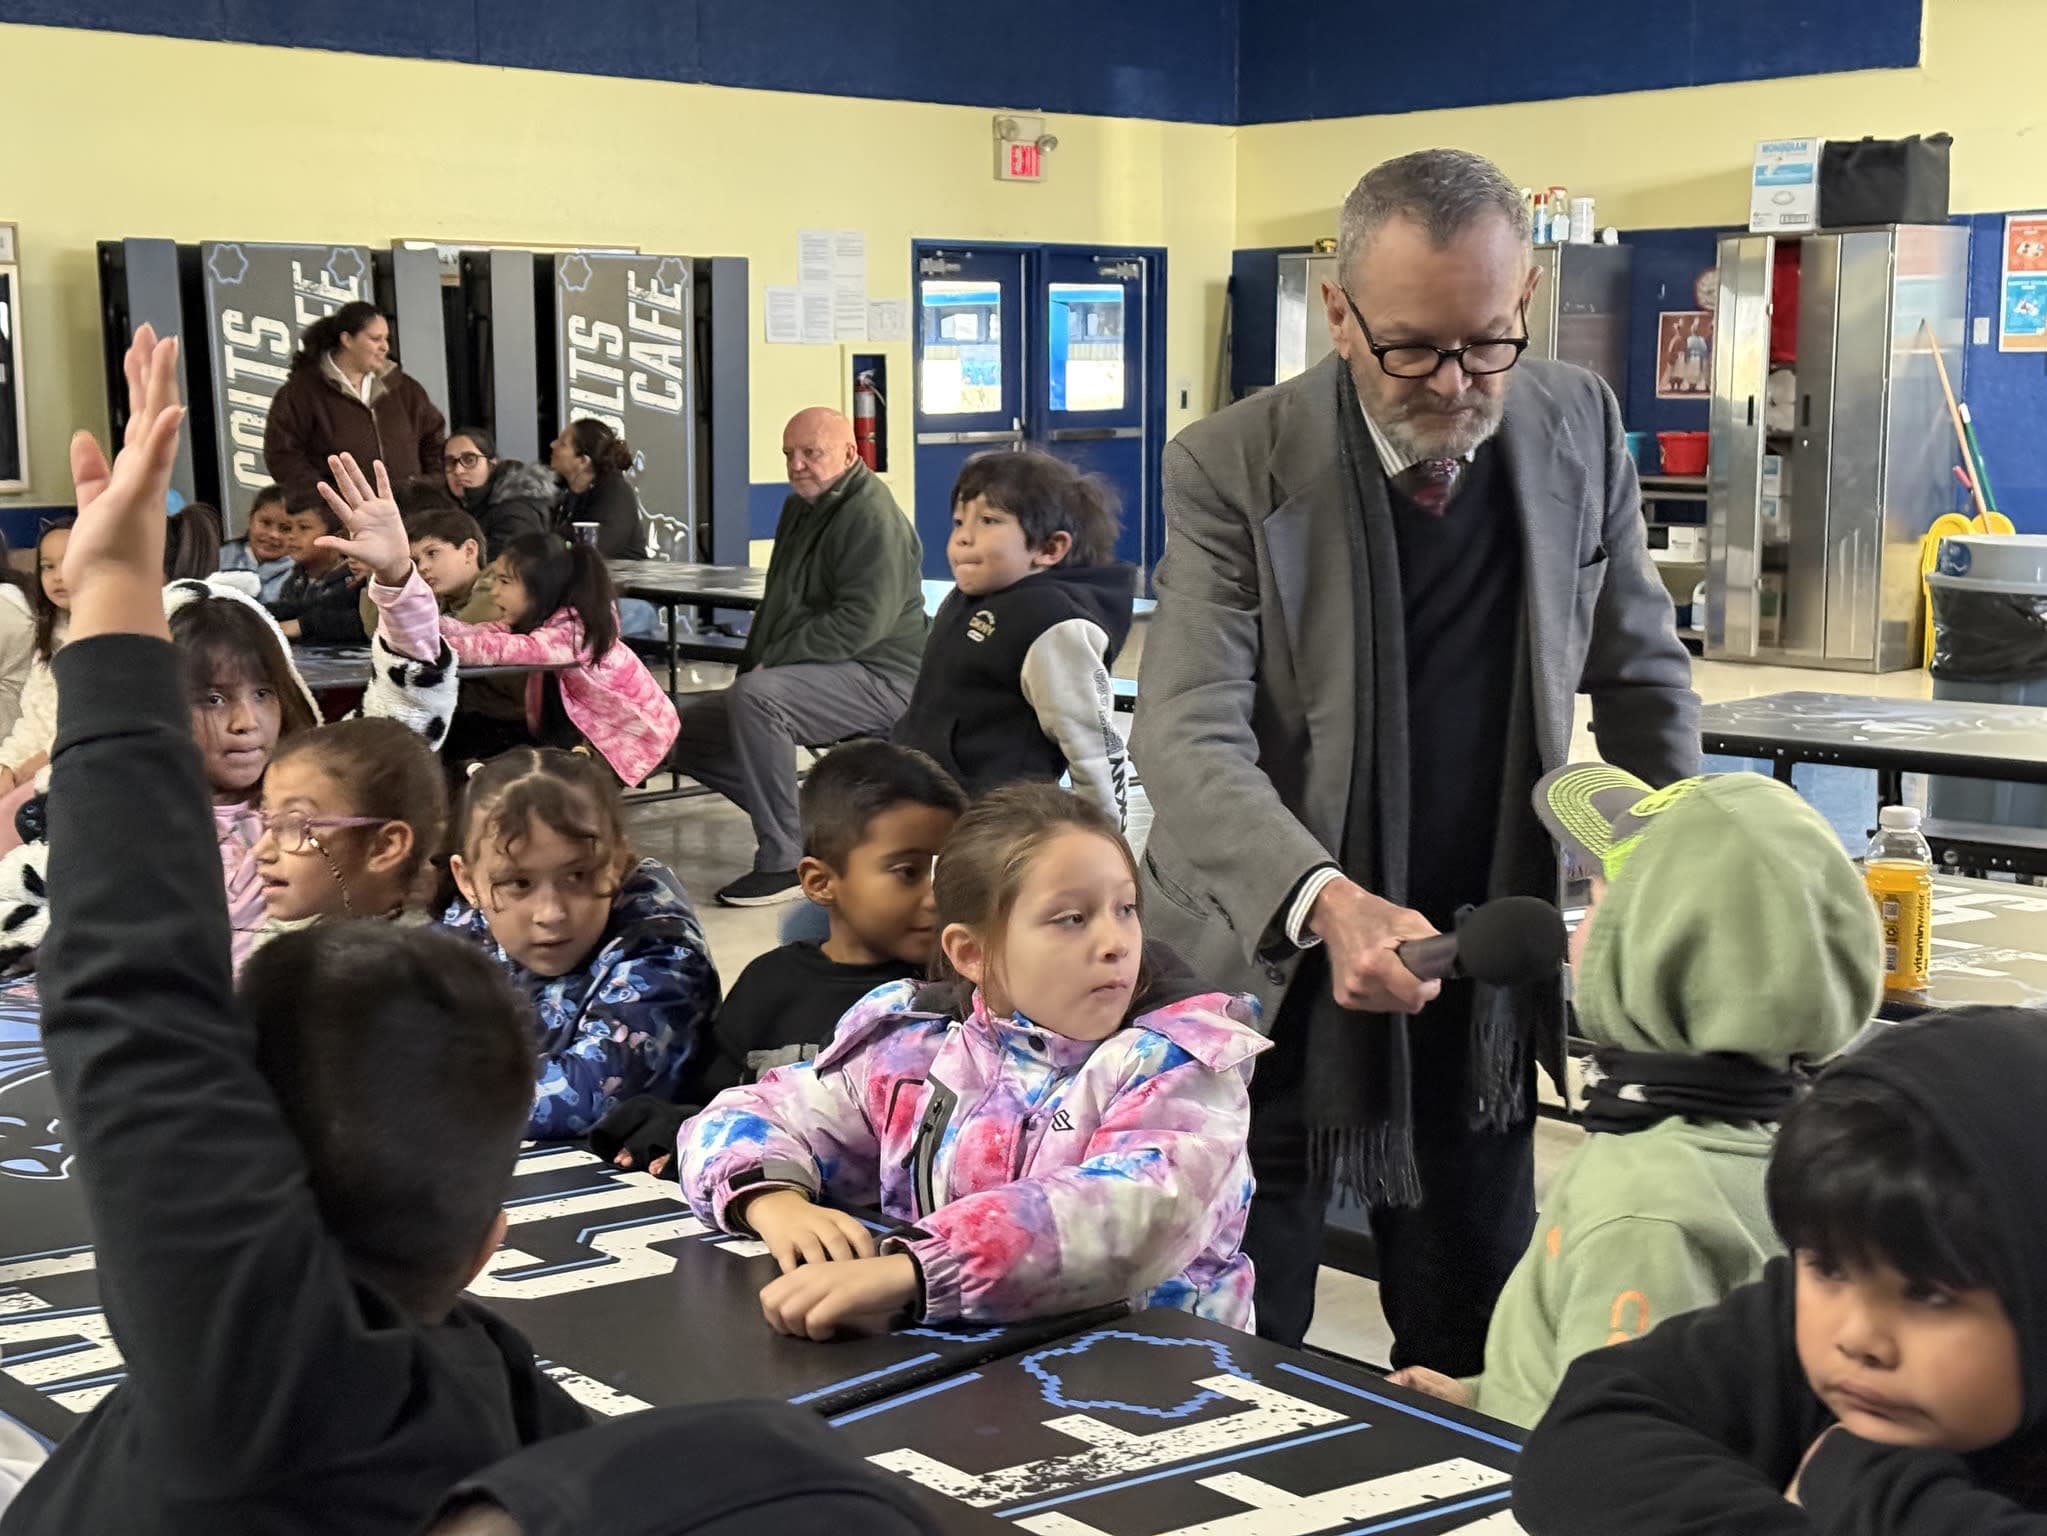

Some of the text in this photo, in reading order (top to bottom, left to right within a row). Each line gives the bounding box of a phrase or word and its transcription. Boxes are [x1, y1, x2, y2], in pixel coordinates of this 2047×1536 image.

[292, 261, 359, 352] FE
[627, 270, 684, 412] CAFE
[568, 315, 625, 441] LTS
